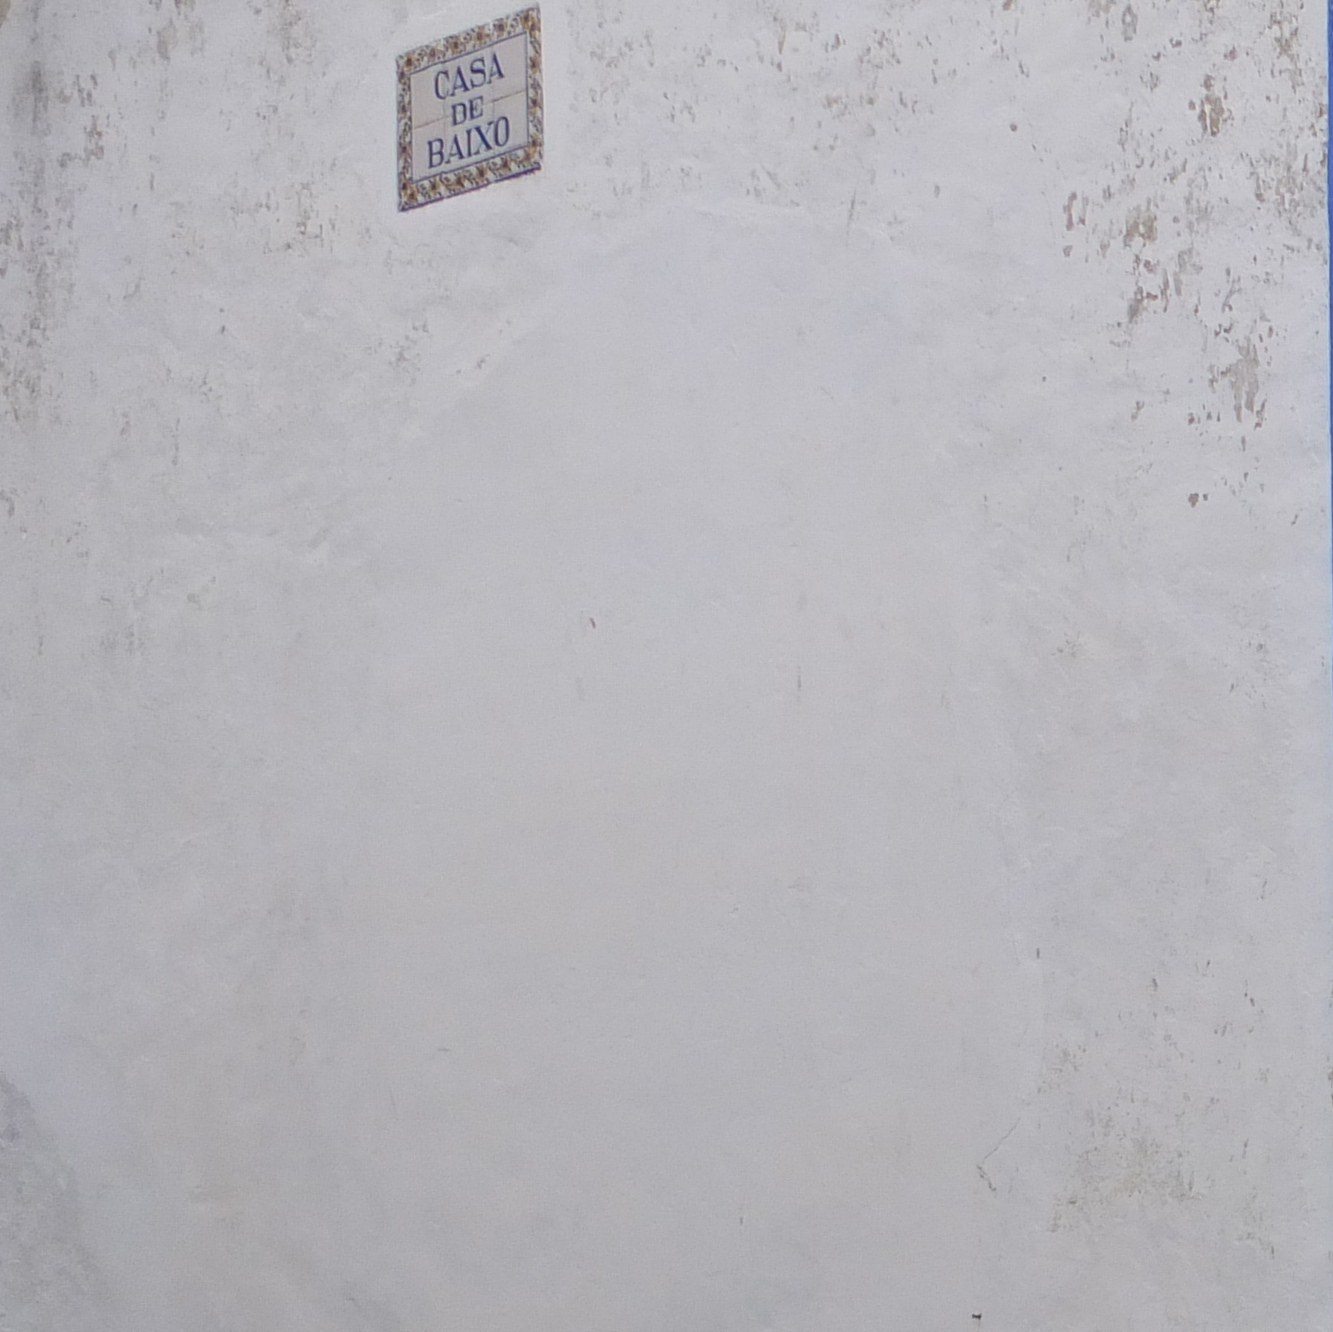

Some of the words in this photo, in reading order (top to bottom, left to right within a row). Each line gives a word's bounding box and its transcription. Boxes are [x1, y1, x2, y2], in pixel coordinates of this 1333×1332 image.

[434, 52, 505, 100] CASA
[451, 96, 484, 126] DE
[427, 116, 510, 169] BAIXO
